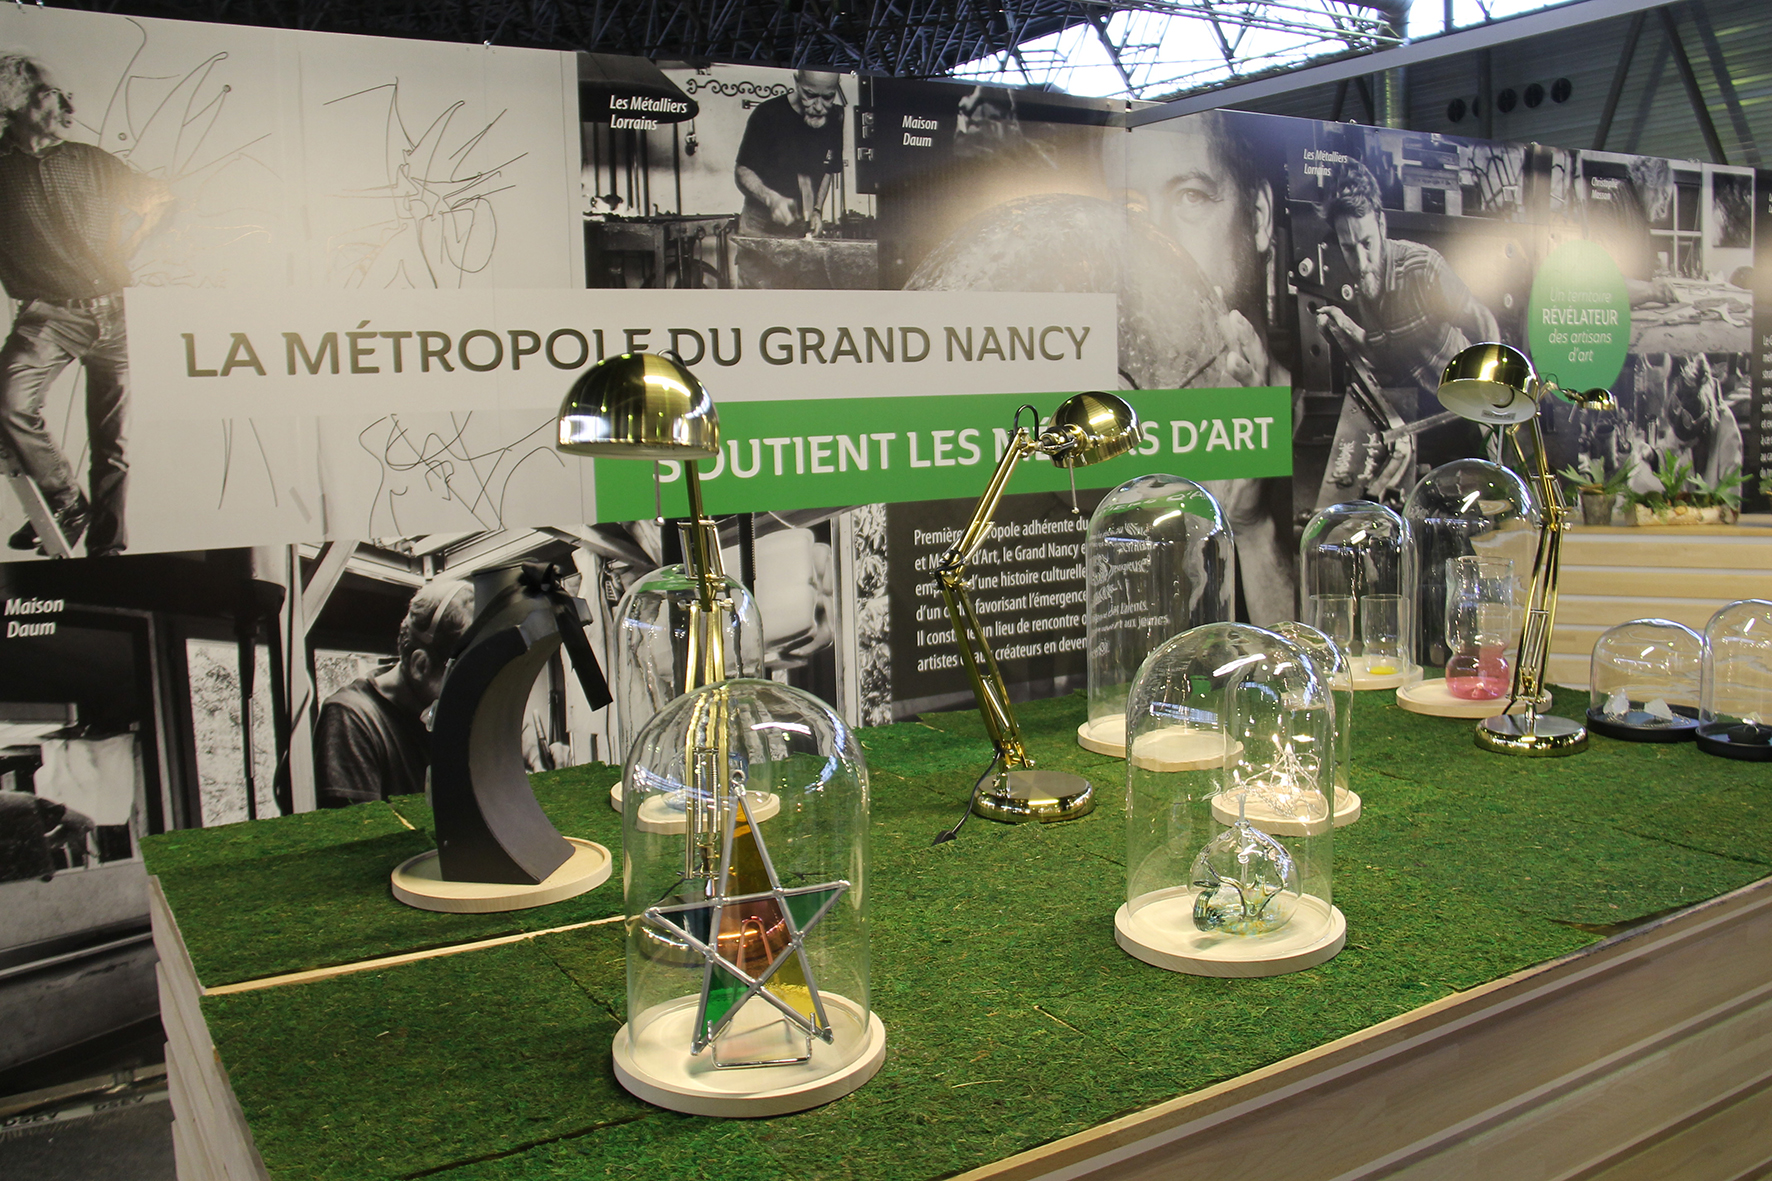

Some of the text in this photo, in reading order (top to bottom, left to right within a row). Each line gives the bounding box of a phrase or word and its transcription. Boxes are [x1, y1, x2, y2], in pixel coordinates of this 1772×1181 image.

[609, 94, 688, 113] Les Métalliers
[610, 114, 658, 131] Lorrains
[902, 115, 938, 130] Maison
[902, 132, 932, 147] Daum
[1303, 148, 1315, 160] Les
[1542, 305, 1619, 326] RÉVÉLATEUR
[1548, 328, 1613, 344] des artisans
[180, 332, 267, 378] LA
[667, 327, 741, 367] DU
[758, 325, 931, 366] GRAND
[943, 325, 1091, 362] NANCY
[1568, 346, 1594, 363] d'art
[906, 428, 981, 468] LES
[1170, 416, 1274, 454] D'ART
[1022, 518, 1074, 537] adhérente
[1075, 515, 1089, 532] du
[914, 556, 927, 571] et
[972, 548, 1001, 566] d'Art,
[1002, 546, 1013, 563] le
[1014, 542, 1046, 562] Grand
[1047, 541, 1079, 560] Nancy
[1000, 569, 1039, 587] histoire
[3, 596, 65, 616] Maison
[915, 604, 941, 622] d'un
[975, 595, 1027, 614] favorisant
[6, 620, 57, 639] Daum
[916, 629, 924, 647] Il
[994, 620, 1014, 637] lieu
[1016, 617, 1030, 635] de
[1031, 614, 1079, 632] rencontre
[917, 653, 958, 673] artistes
[994, 643, 1042, 662] créateurs
[1043, 641, 1056, 655] en
